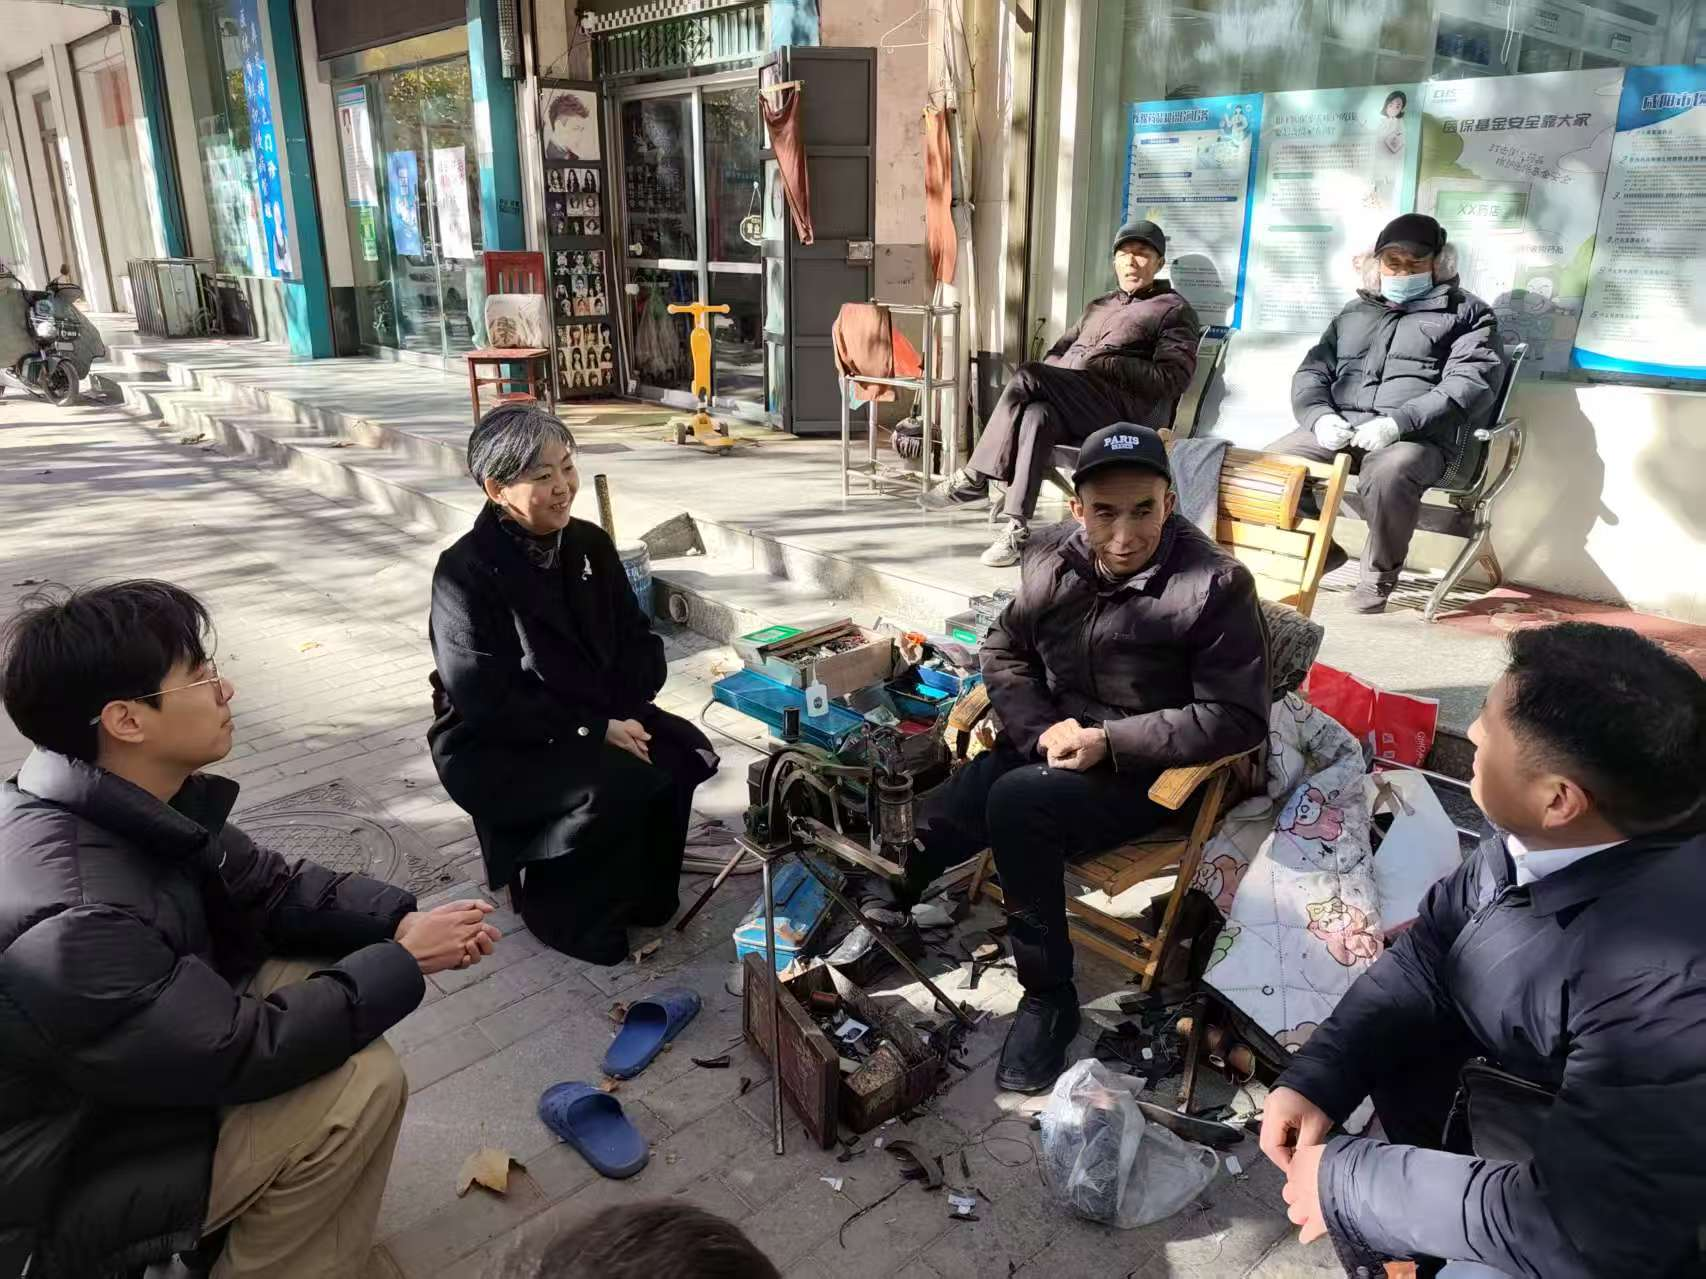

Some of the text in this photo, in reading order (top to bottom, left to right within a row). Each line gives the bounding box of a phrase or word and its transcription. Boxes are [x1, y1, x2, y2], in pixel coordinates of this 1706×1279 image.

[1442, 113, 1592, 134] 医保基金安全靠大家
[1103, 435, 1140, 447] PARIS
